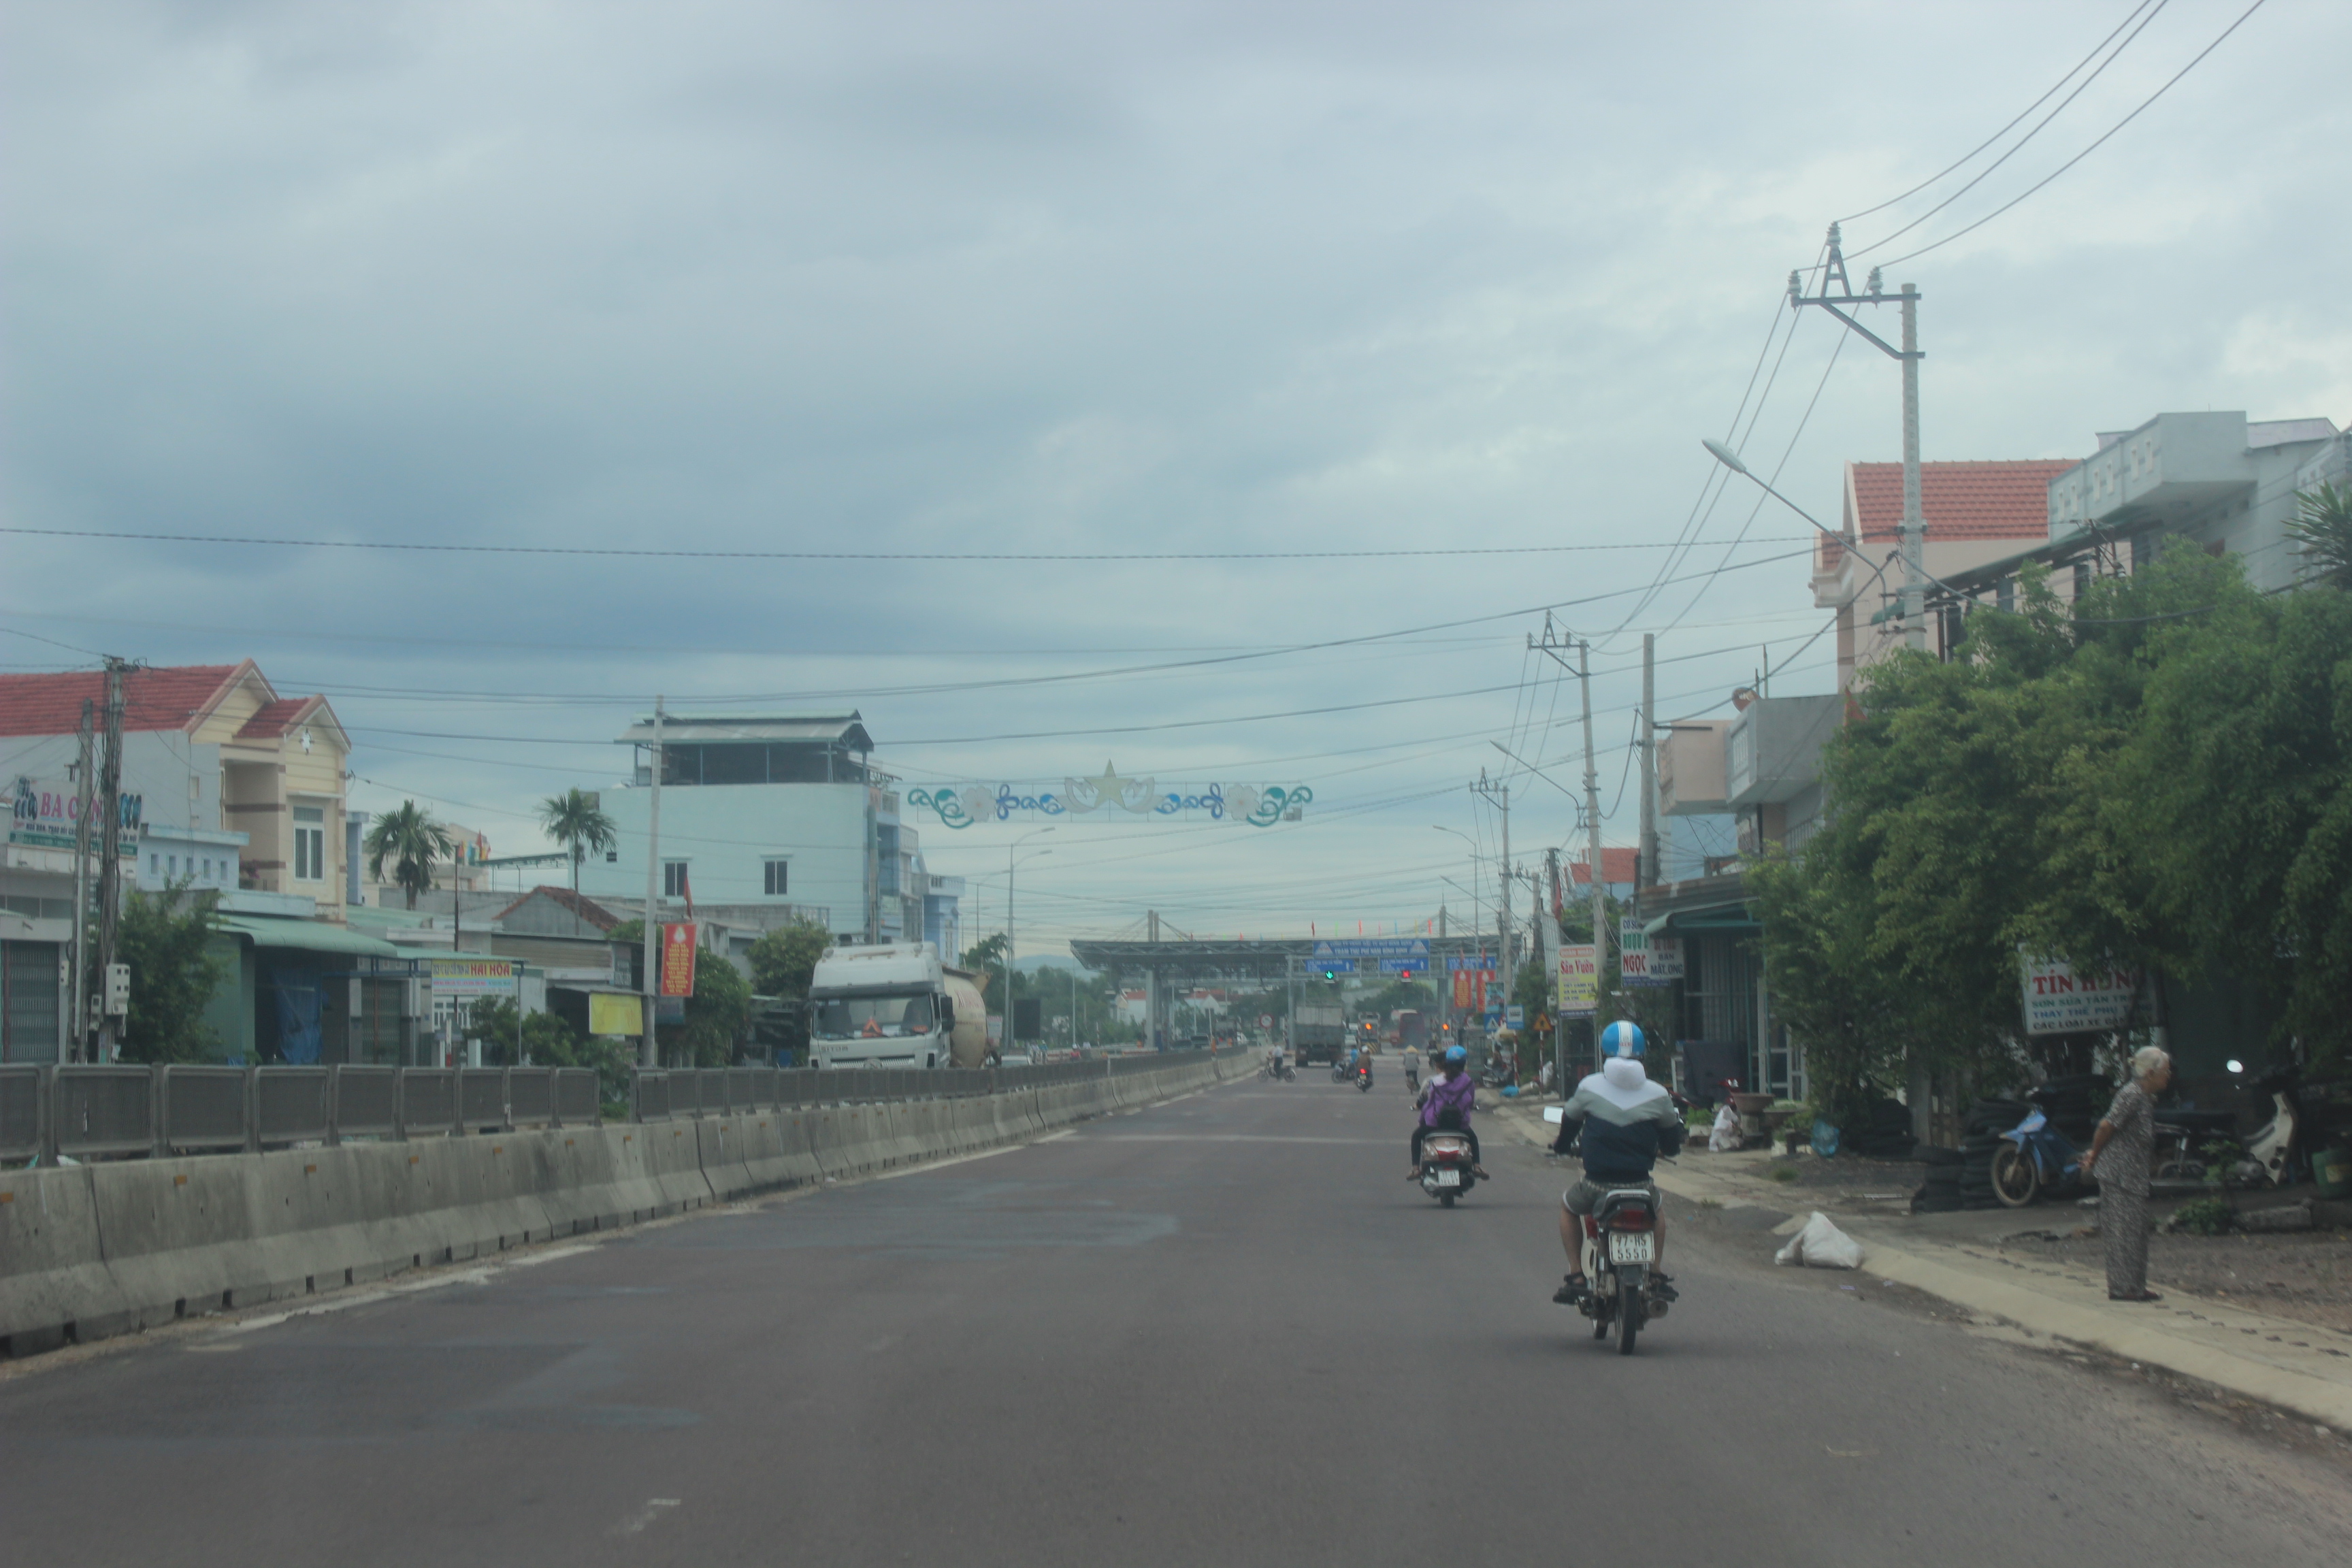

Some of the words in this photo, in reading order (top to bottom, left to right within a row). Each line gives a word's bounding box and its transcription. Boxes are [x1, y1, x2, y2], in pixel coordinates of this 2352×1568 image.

[1622, 953, 1646, 976] NGỌC
[1668, 963, 1683, 975] ONG
[2033, 1010, 2063, 1019] THAY
[2068, 1006, 2089, 1016] THẾ
[2087, 1018, 2100, 1026] XE
[1618, 1248, 1647, 1260] 5550
